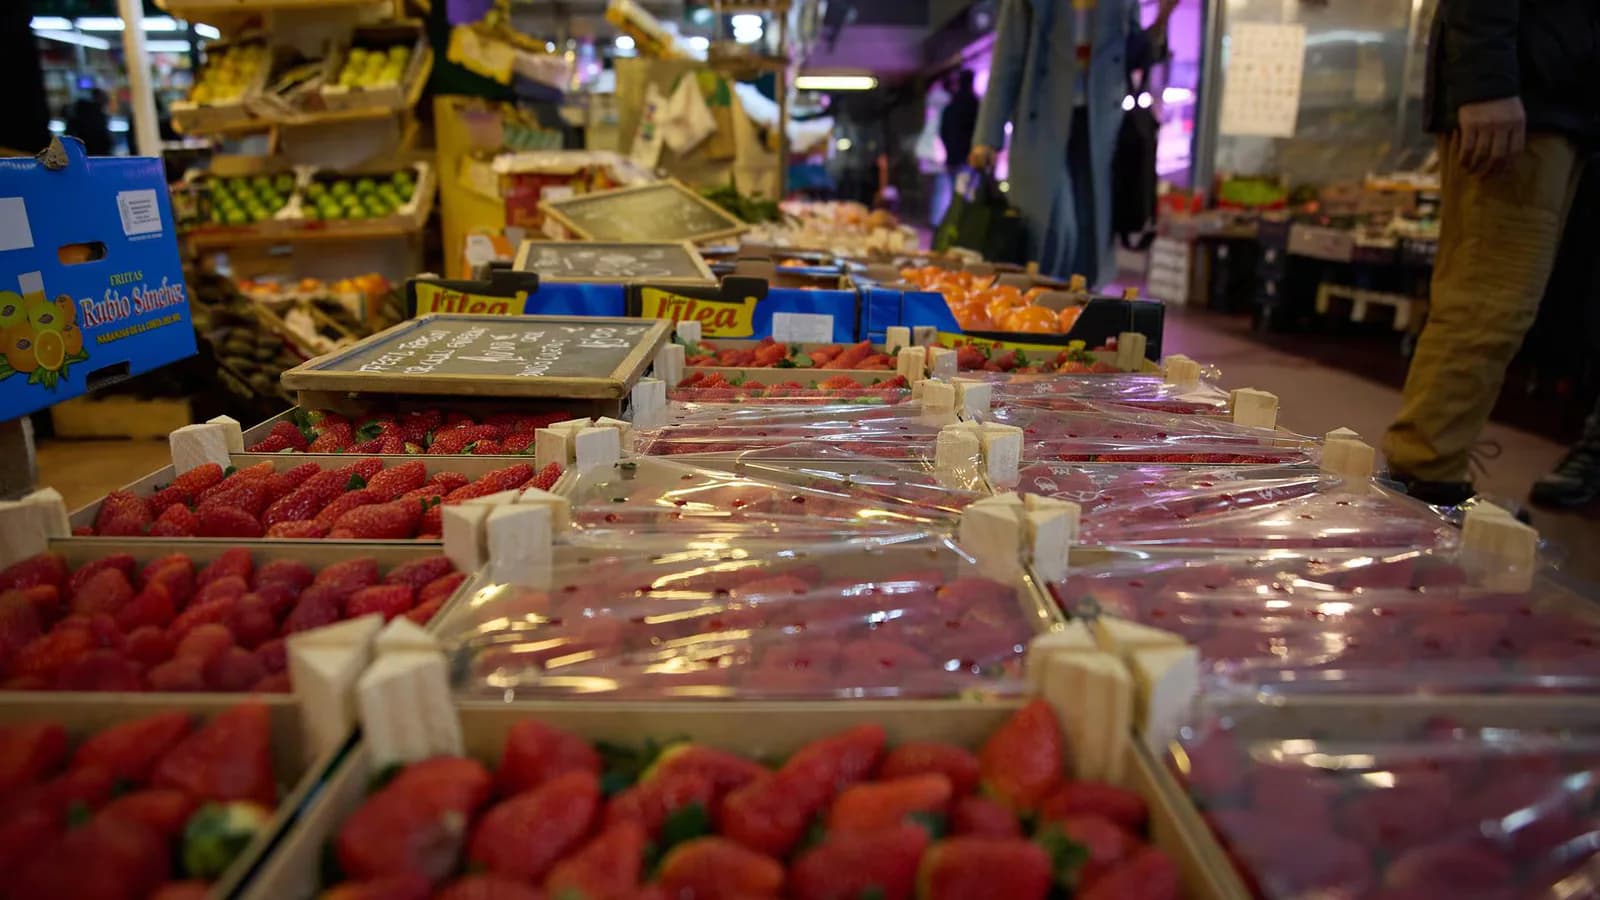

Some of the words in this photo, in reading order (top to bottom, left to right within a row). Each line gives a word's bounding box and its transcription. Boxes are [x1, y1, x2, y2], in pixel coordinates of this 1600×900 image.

[110, 270, 143, 286] FRUTAS
[80, 288, 131, 328] Rubio
[132, 276, 184, 315] Sánchez
